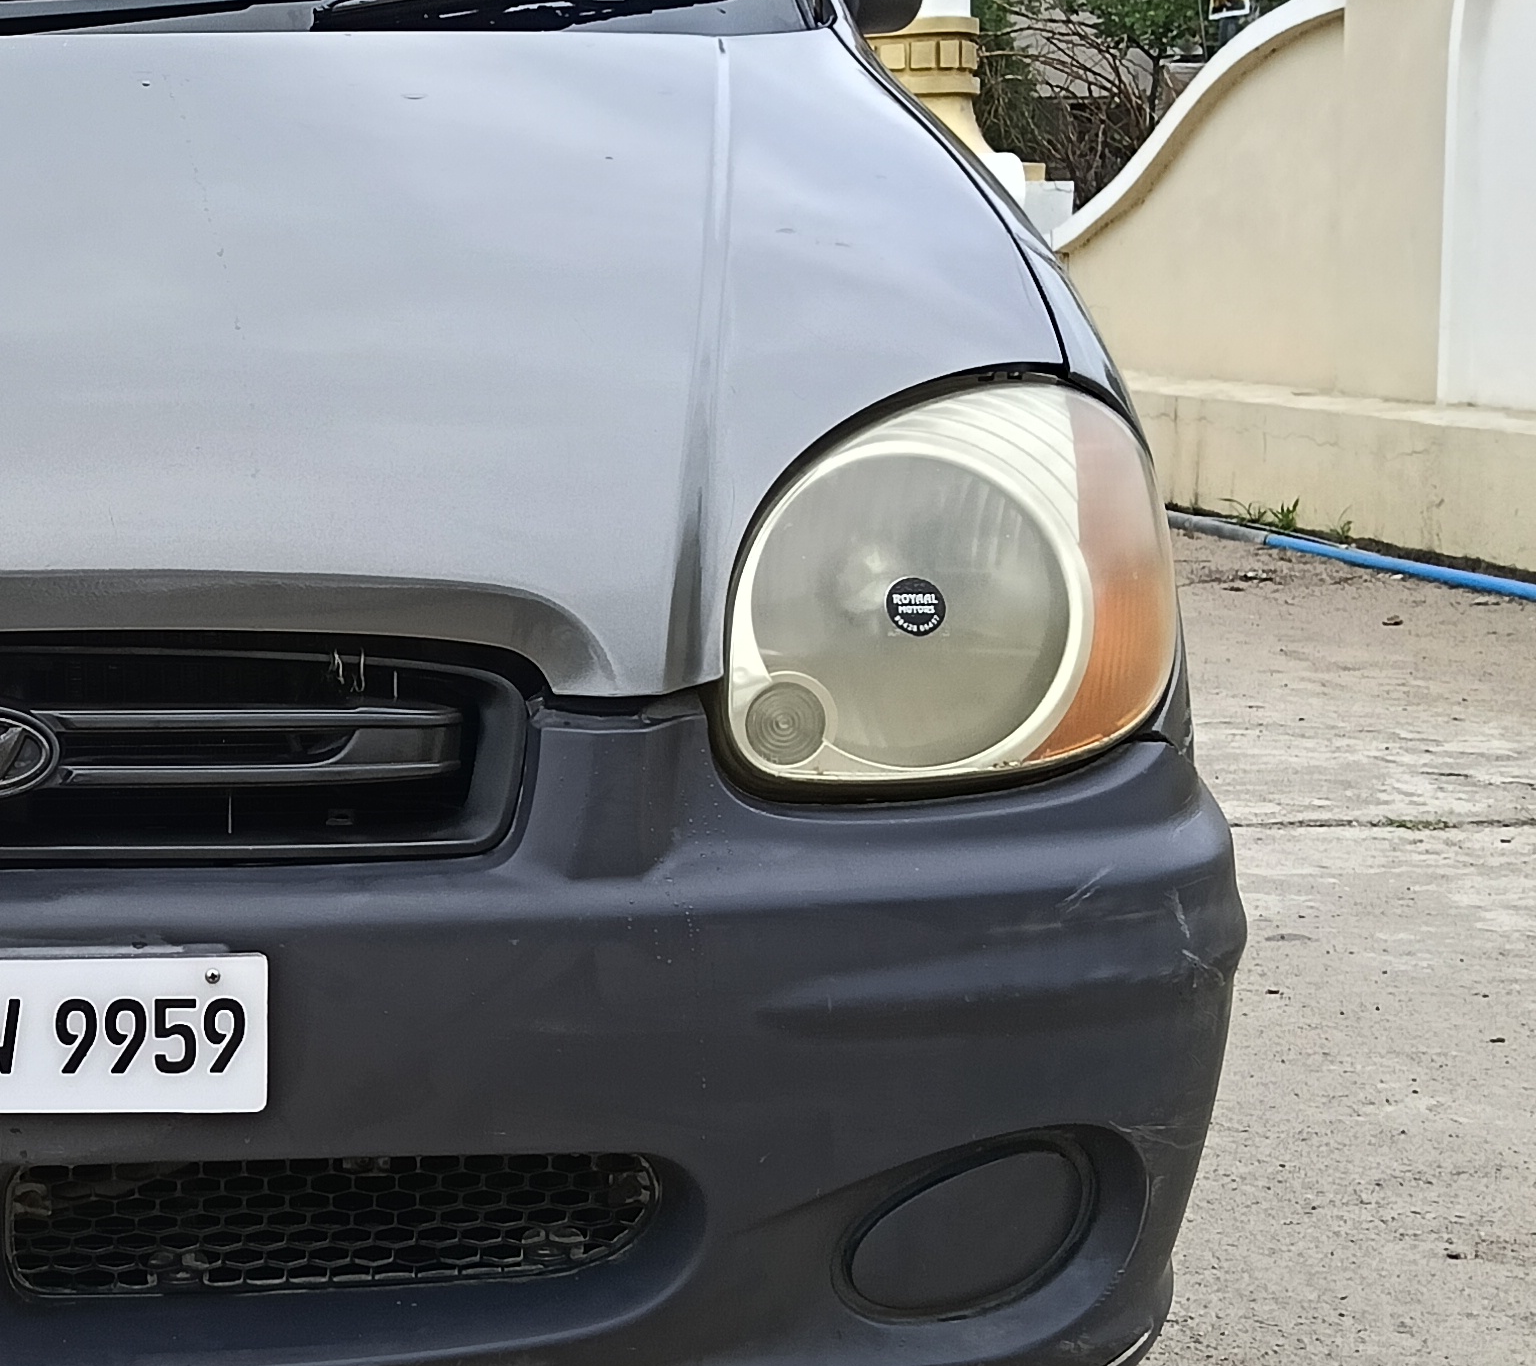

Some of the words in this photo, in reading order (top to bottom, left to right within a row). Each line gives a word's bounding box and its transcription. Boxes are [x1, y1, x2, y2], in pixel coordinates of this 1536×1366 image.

[892, 593, 939, 605] ROYAAL
[898, 605, 936, 614] MOTORS
[55, 998, 246, 1075] 9959
